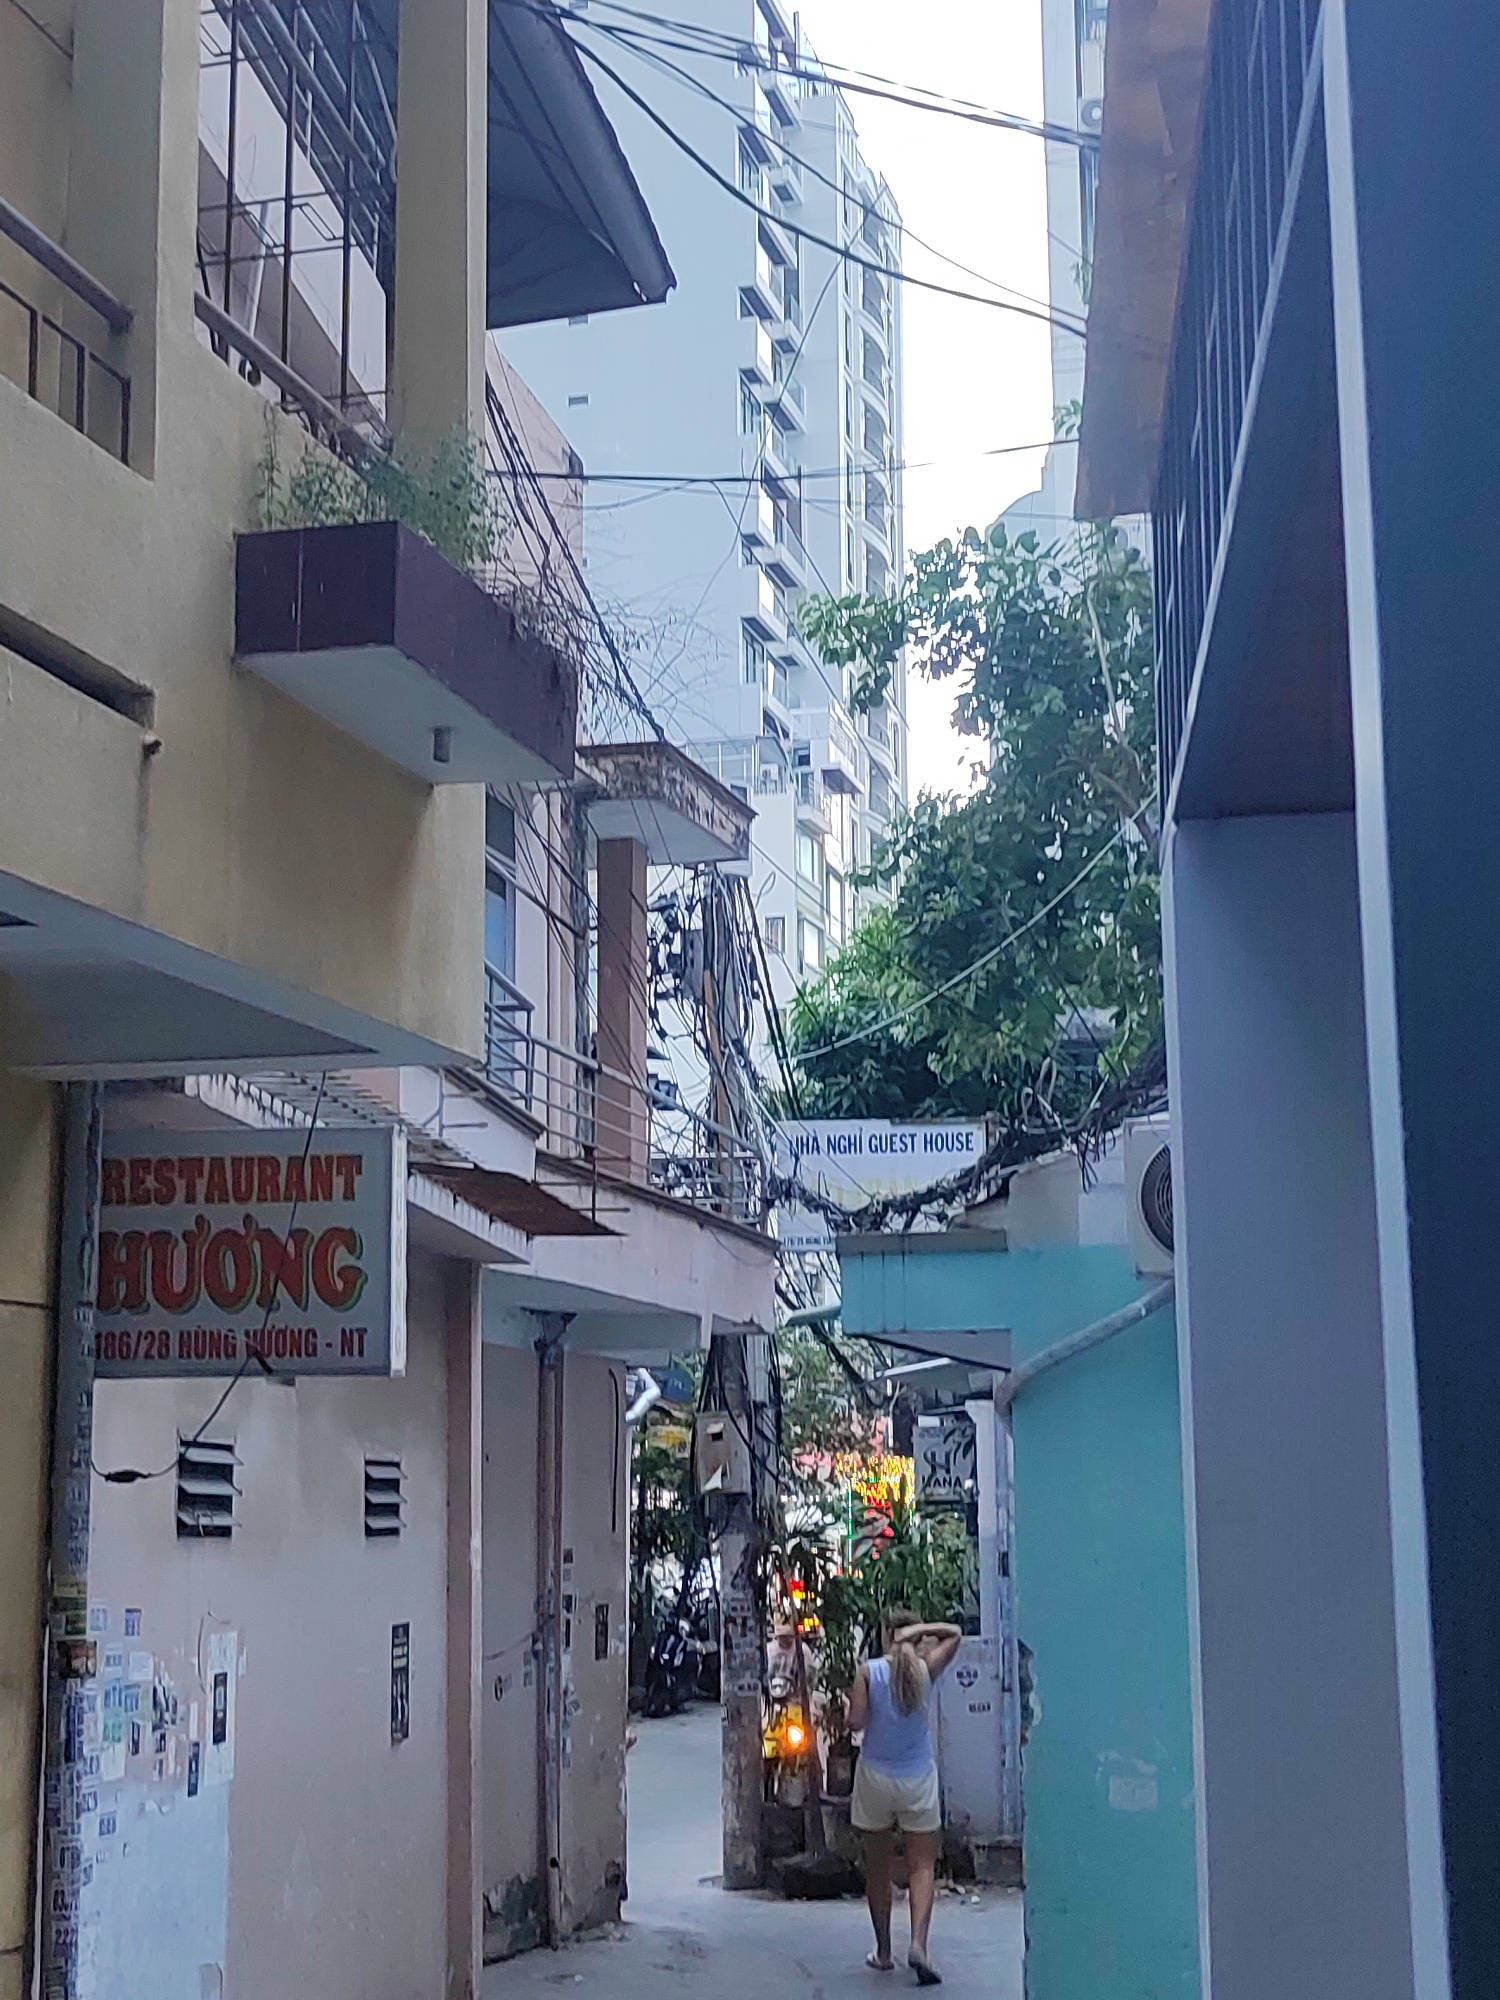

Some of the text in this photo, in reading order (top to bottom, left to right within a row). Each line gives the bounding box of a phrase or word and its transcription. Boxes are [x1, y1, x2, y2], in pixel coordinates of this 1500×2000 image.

[868, 1132, 917, 1154] GUEST
[923, 1131, 974, 1153] HOUSE
[101, 1154, 363, 1204] RESTAURANT
[97, 1212, 368, 1314] HƯƠNG
[340, 1326, 368, 1358] NT
